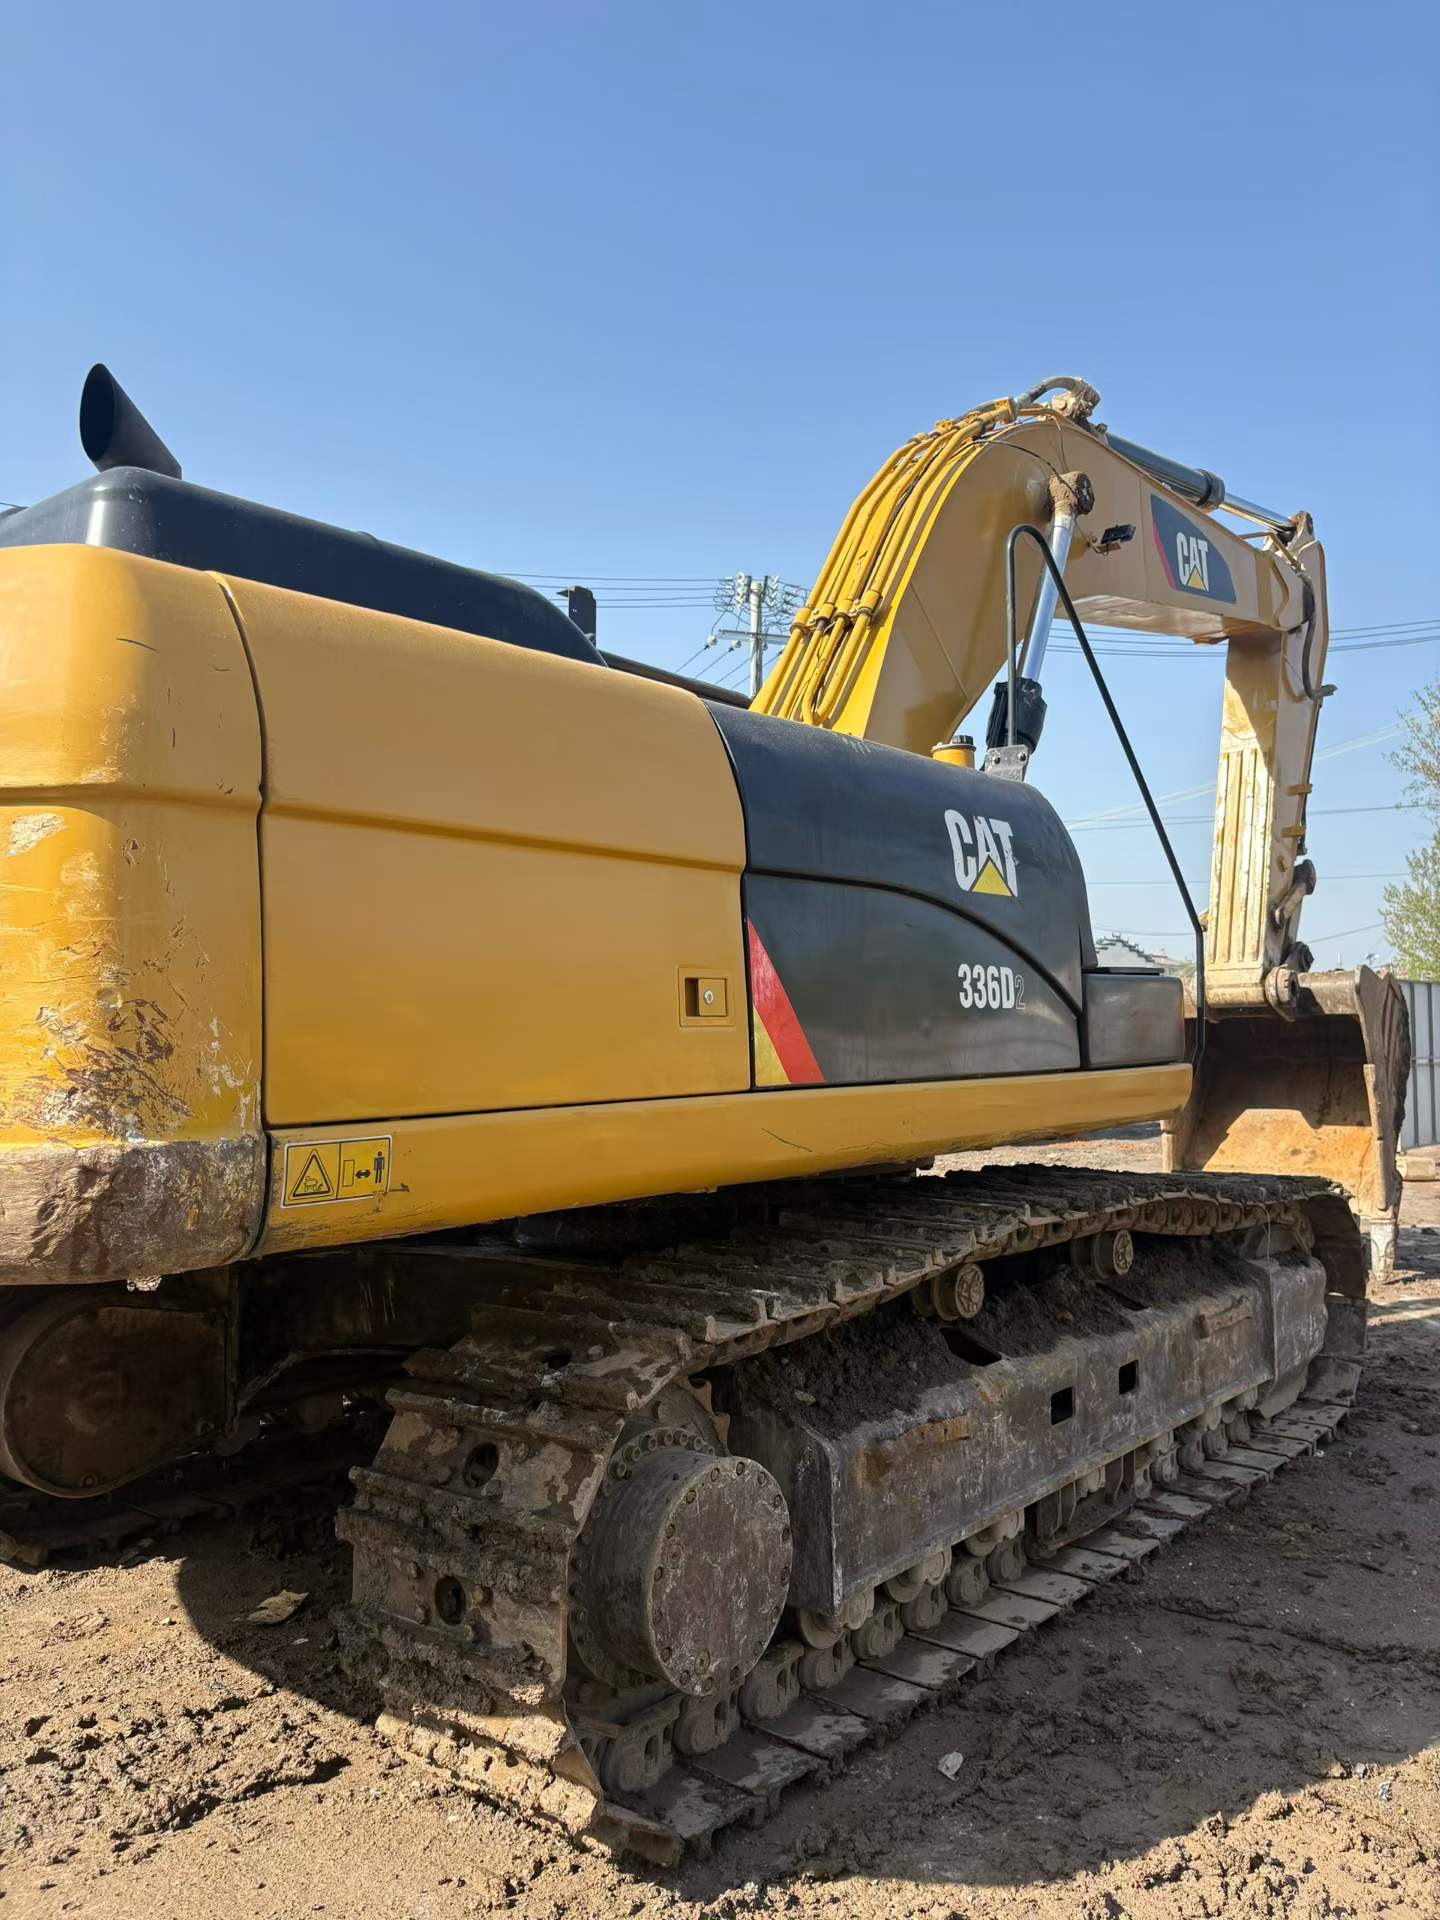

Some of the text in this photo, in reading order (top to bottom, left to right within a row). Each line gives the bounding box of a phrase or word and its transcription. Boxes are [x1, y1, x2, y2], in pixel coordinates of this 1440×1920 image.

[1176, 532, 1209, 592] CAT
[944, 809, 1018, 897] CAT
[958, 963, 1025, 1010] 336D2
